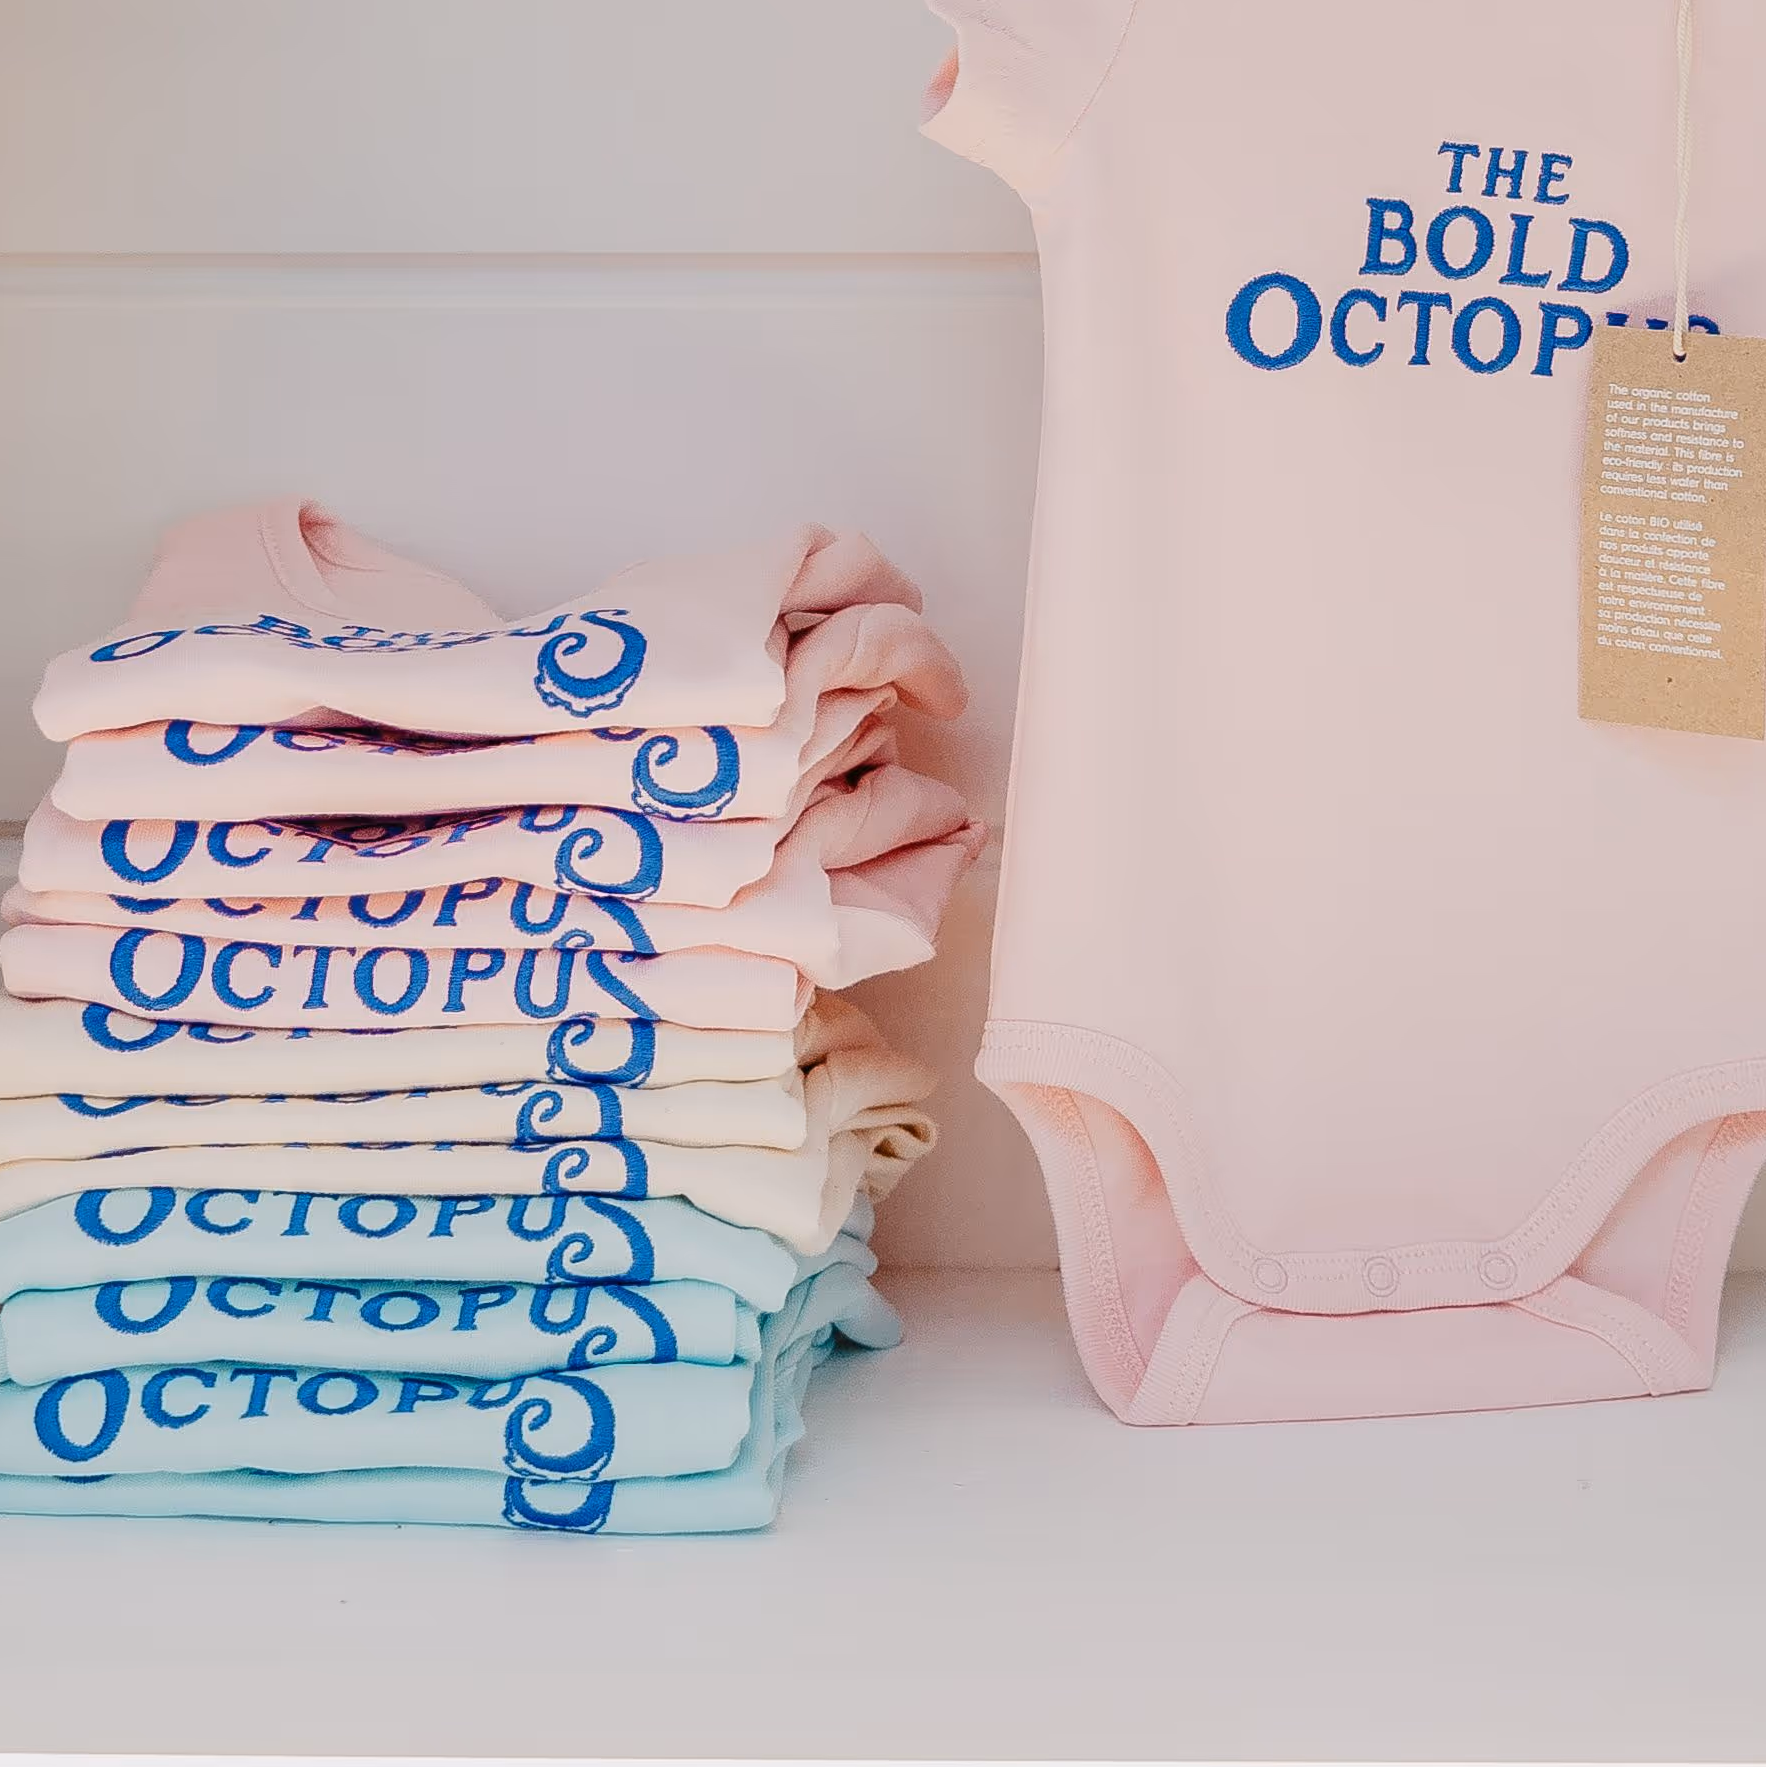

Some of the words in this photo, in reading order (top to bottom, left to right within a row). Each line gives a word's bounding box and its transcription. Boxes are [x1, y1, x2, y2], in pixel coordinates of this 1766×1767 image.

[1438, 141, 1573, 205] THE
[1359, 197, 1629, 294] BOLD
[1226, 271, 1720, 377] OCTOP
[1609, 384, 1628, 395] The
[1631, 387, 1672, 399] organic
[1676, 392, 1710, 402] cotton
[1607, 400, 1633, 410] used
[1651, 403, 1667, 412] the
[1606, 413, 1617, 422] of
[1621, 416, 1640, 424] our
[1643, 418, 1689, 429] products
[1693, 420, 1726, 434] brings
[1605, 428, 1647, 439] softness
[1650, 433, 1672, 442] and
[1733, 439, 1744, 449] to
[1604, 441, 1621, 451] the
[1674, 447, 1694, 458] This
[1698, 449, 1722, 460] fibre
[1726, 452, 1735, 462] is
[1646, 474, 1667, 484] less
[1704, 479, 1728, 490] than
[1650, 517, 1669, 527] BIO
[75, 1185, 656, 1284] OCTOPUS
